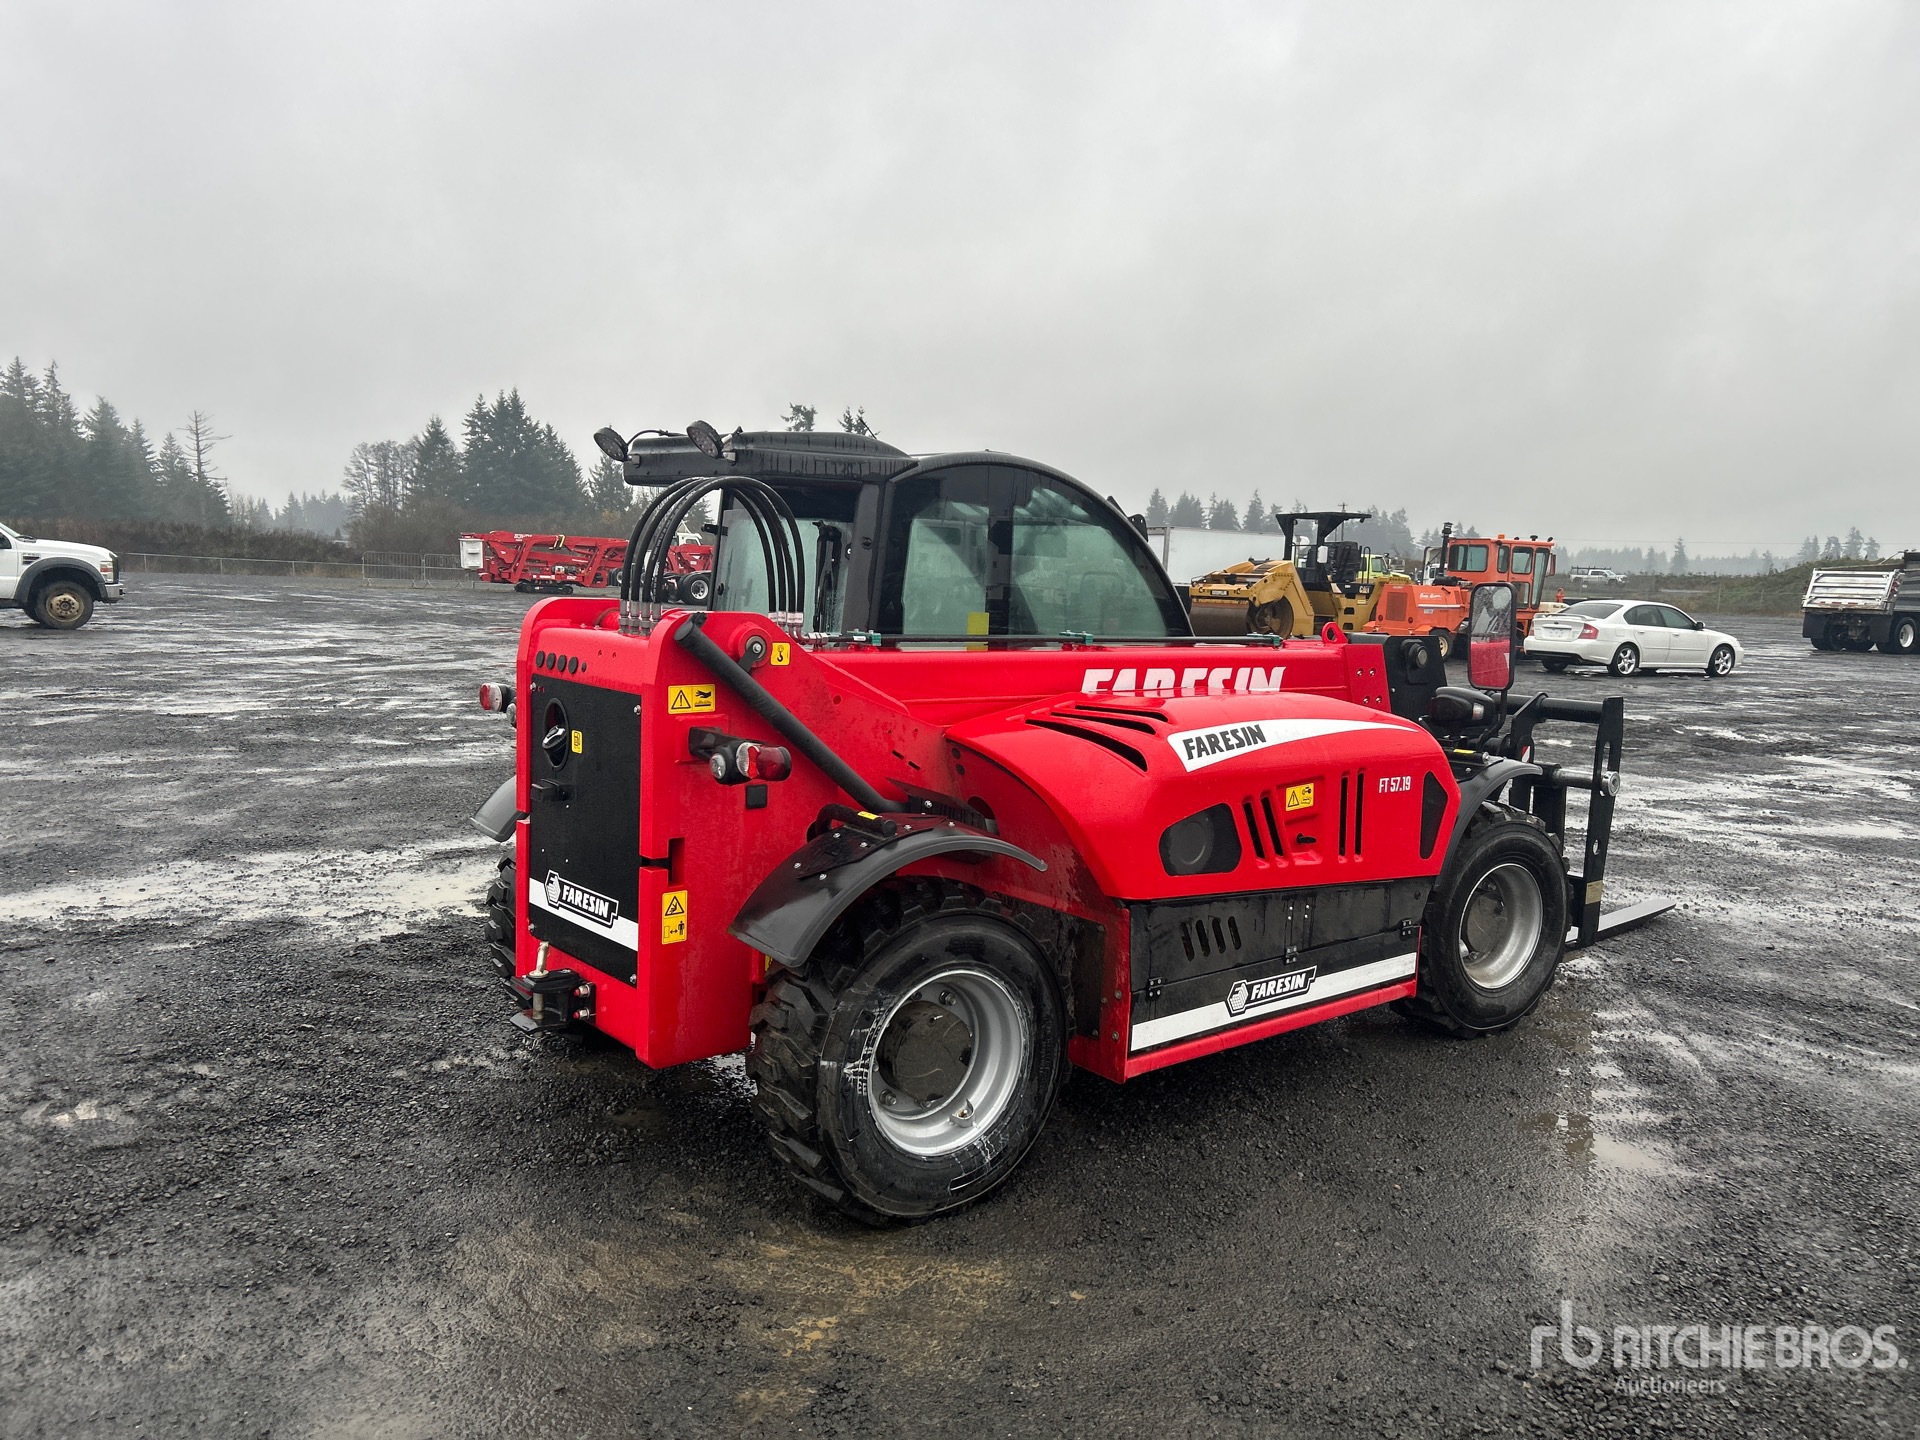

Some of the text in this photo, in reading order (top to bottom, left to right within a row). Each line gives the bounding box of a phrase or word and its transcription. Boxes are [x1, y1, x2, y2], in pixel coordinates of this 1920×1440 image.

[1182, 724, 1267, 760] FARESIN
[1378, 775, 1411, 793] FT 57.19
[562, 884, 610, 918] FARESIN
[1250, 972, 1307, 1001] FARESIN
